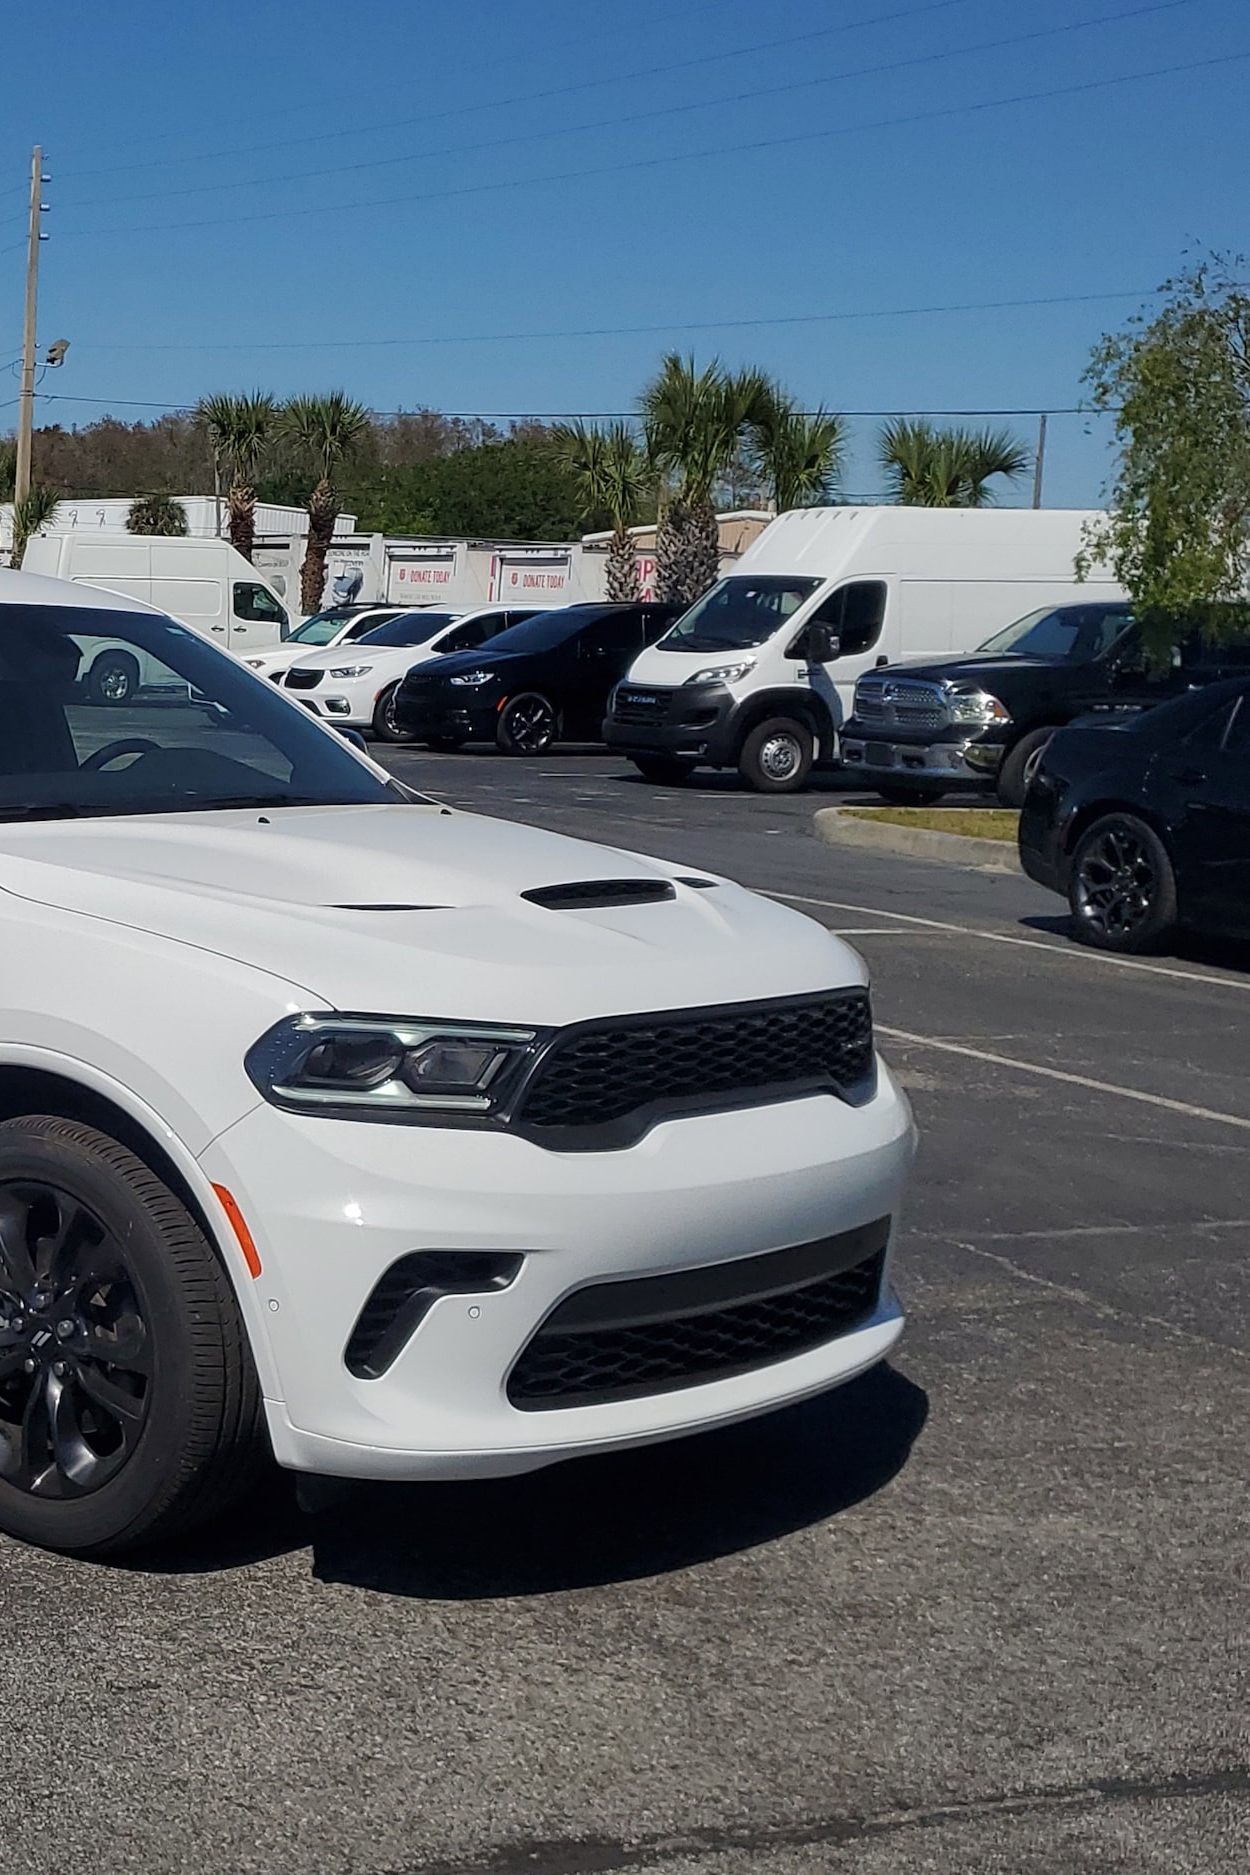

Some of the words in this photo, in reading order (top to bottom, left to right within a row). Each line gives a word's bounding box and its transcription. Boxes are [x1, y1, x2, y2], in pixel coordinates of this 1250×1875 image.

[410, 570, 432, 583] DONATE
[433, 571, 450, 584] TODAY
[522, 574, 546, 588] DONATE
[547, 575, 564, 588] TODAY
